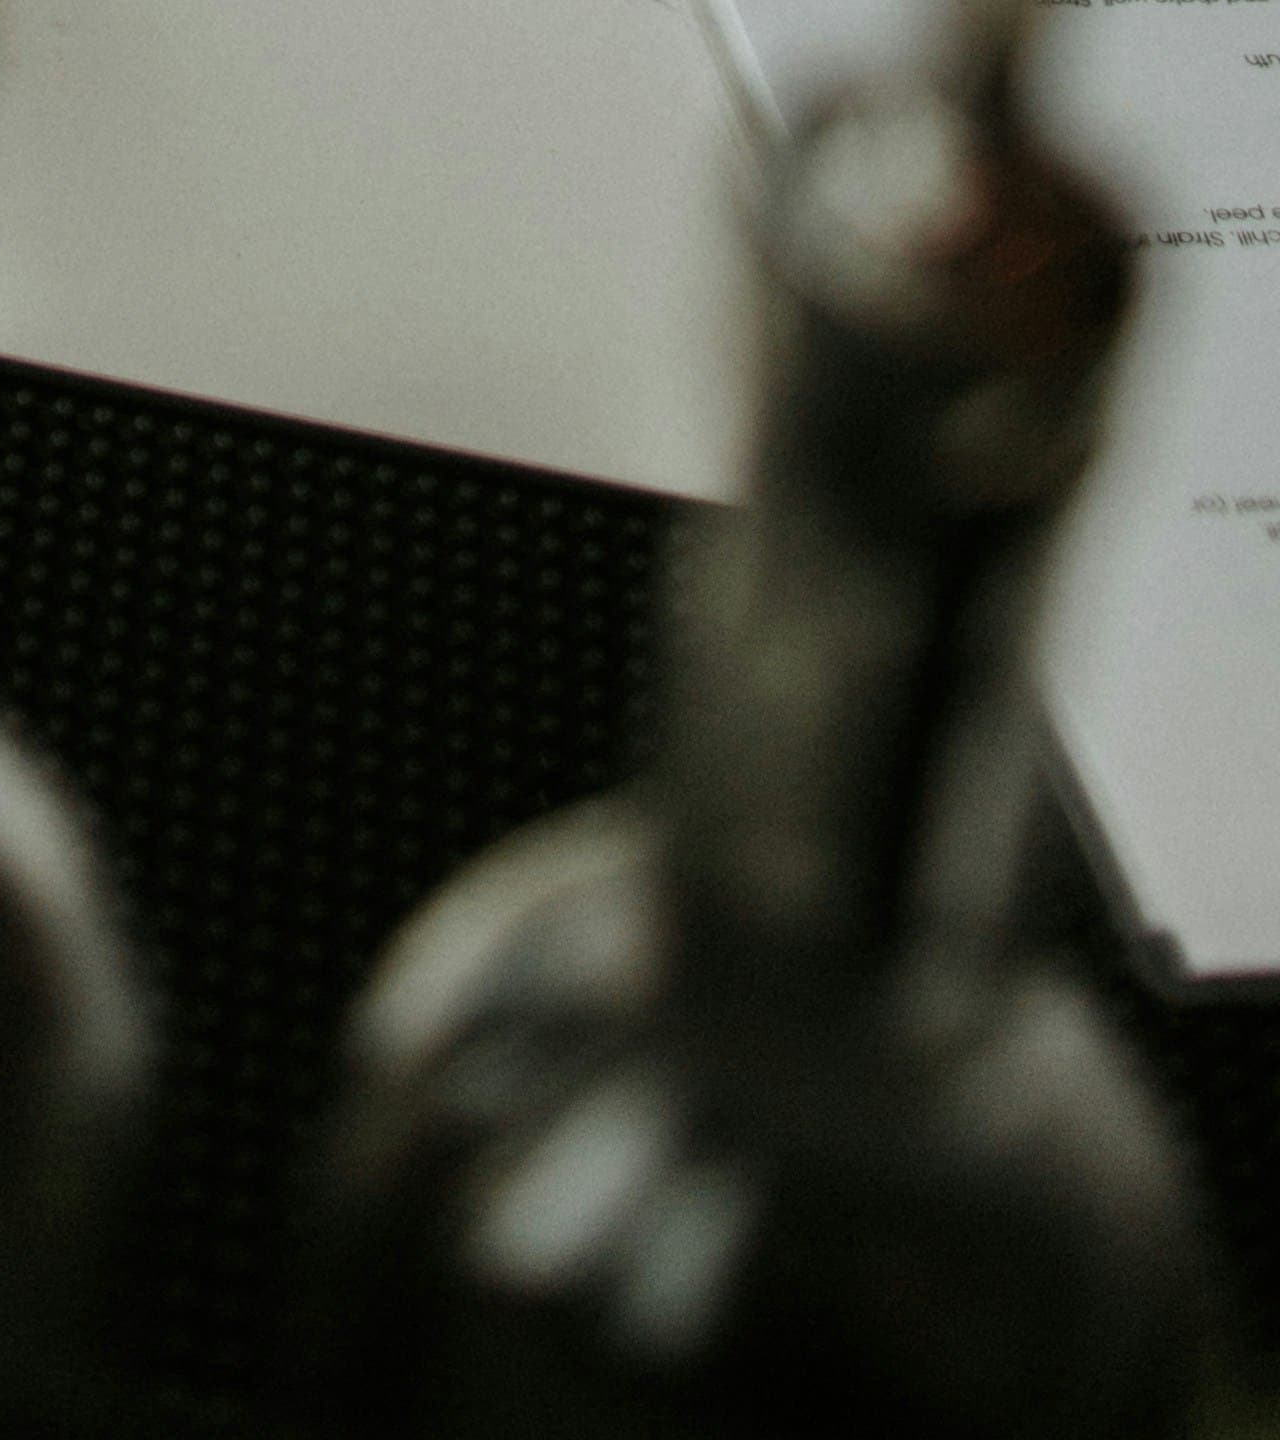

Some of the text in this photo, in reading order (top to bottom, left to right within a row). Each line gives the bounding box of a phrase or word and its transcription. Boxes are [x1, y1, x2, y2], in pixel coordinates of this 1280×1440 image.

[1203, 202, 1265, 224] peel.
[1156, 229, 1225, 248] Strain
[1229, 229, 1280, 247] chill.
